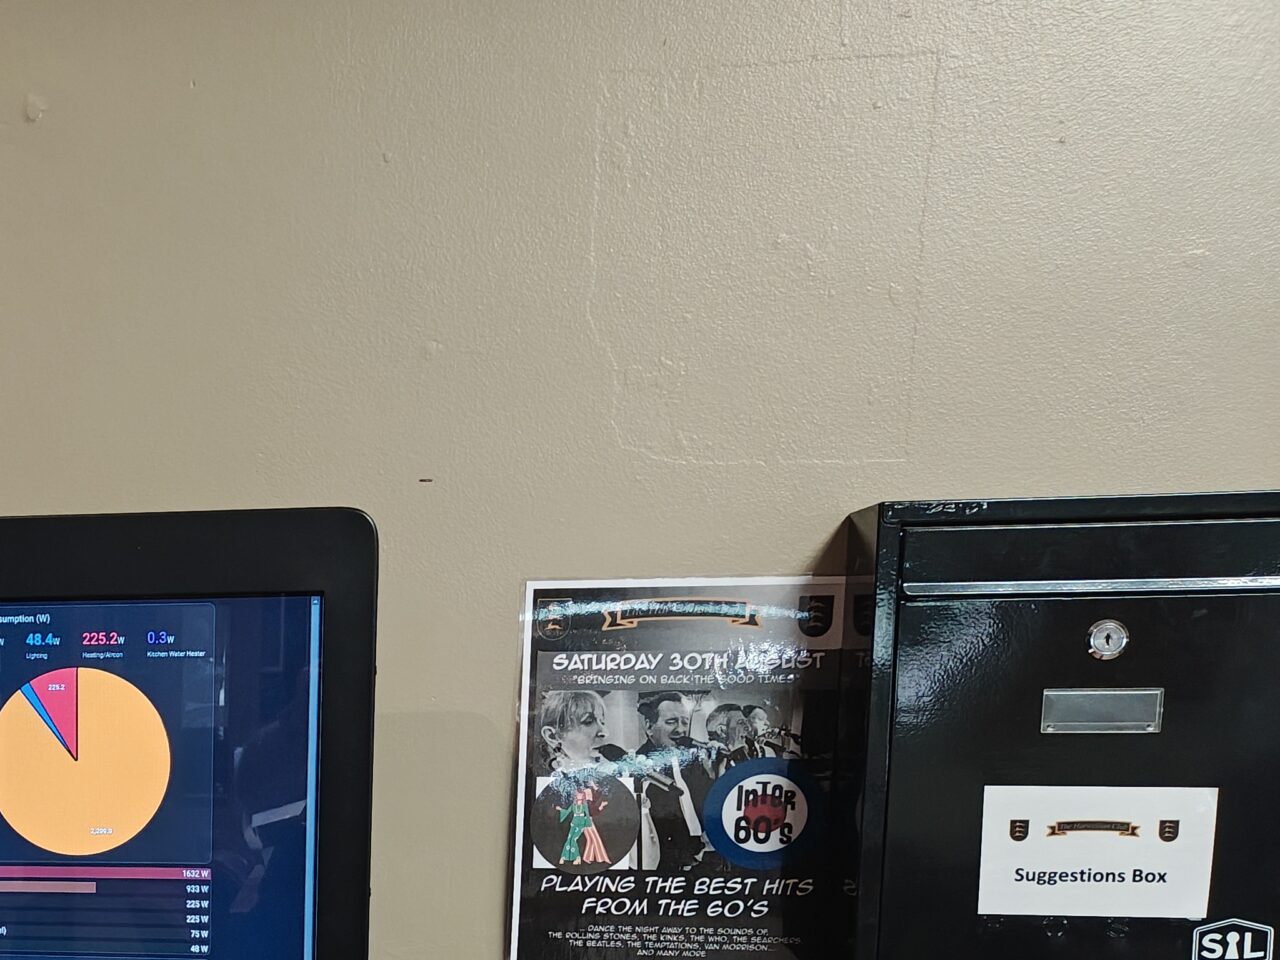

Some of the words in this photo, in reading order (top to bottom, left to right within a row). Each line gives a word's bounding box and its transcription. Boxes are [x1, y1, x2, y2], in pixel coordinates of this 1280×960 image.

[36, 614, 50, 624] (W)
[552, 652, 664, 671] SATURDAY
[669, 652, 727, 671] 30TH
[639, 674, 657, 684] ON
[660, 674, 689, 684] BACK
[691, 674, 716, 684] THE
[182, 870, 200, 878] 1632
[201, 870, 209, 878] W
[1014, 867, 1125, 885] Suggestions
[1132, 869, 1167, 883] Box
[541, 875, 636, 892] PLAYING
[646, 876, 689, 894] THE
[694, 878, 758, 895] BEST
[762, 879, 814, 896] HITS
[582, 899, 648, 916] FROM
[658, 900, 700, 916] THE
[706, 900, 769, 918] 60'S
